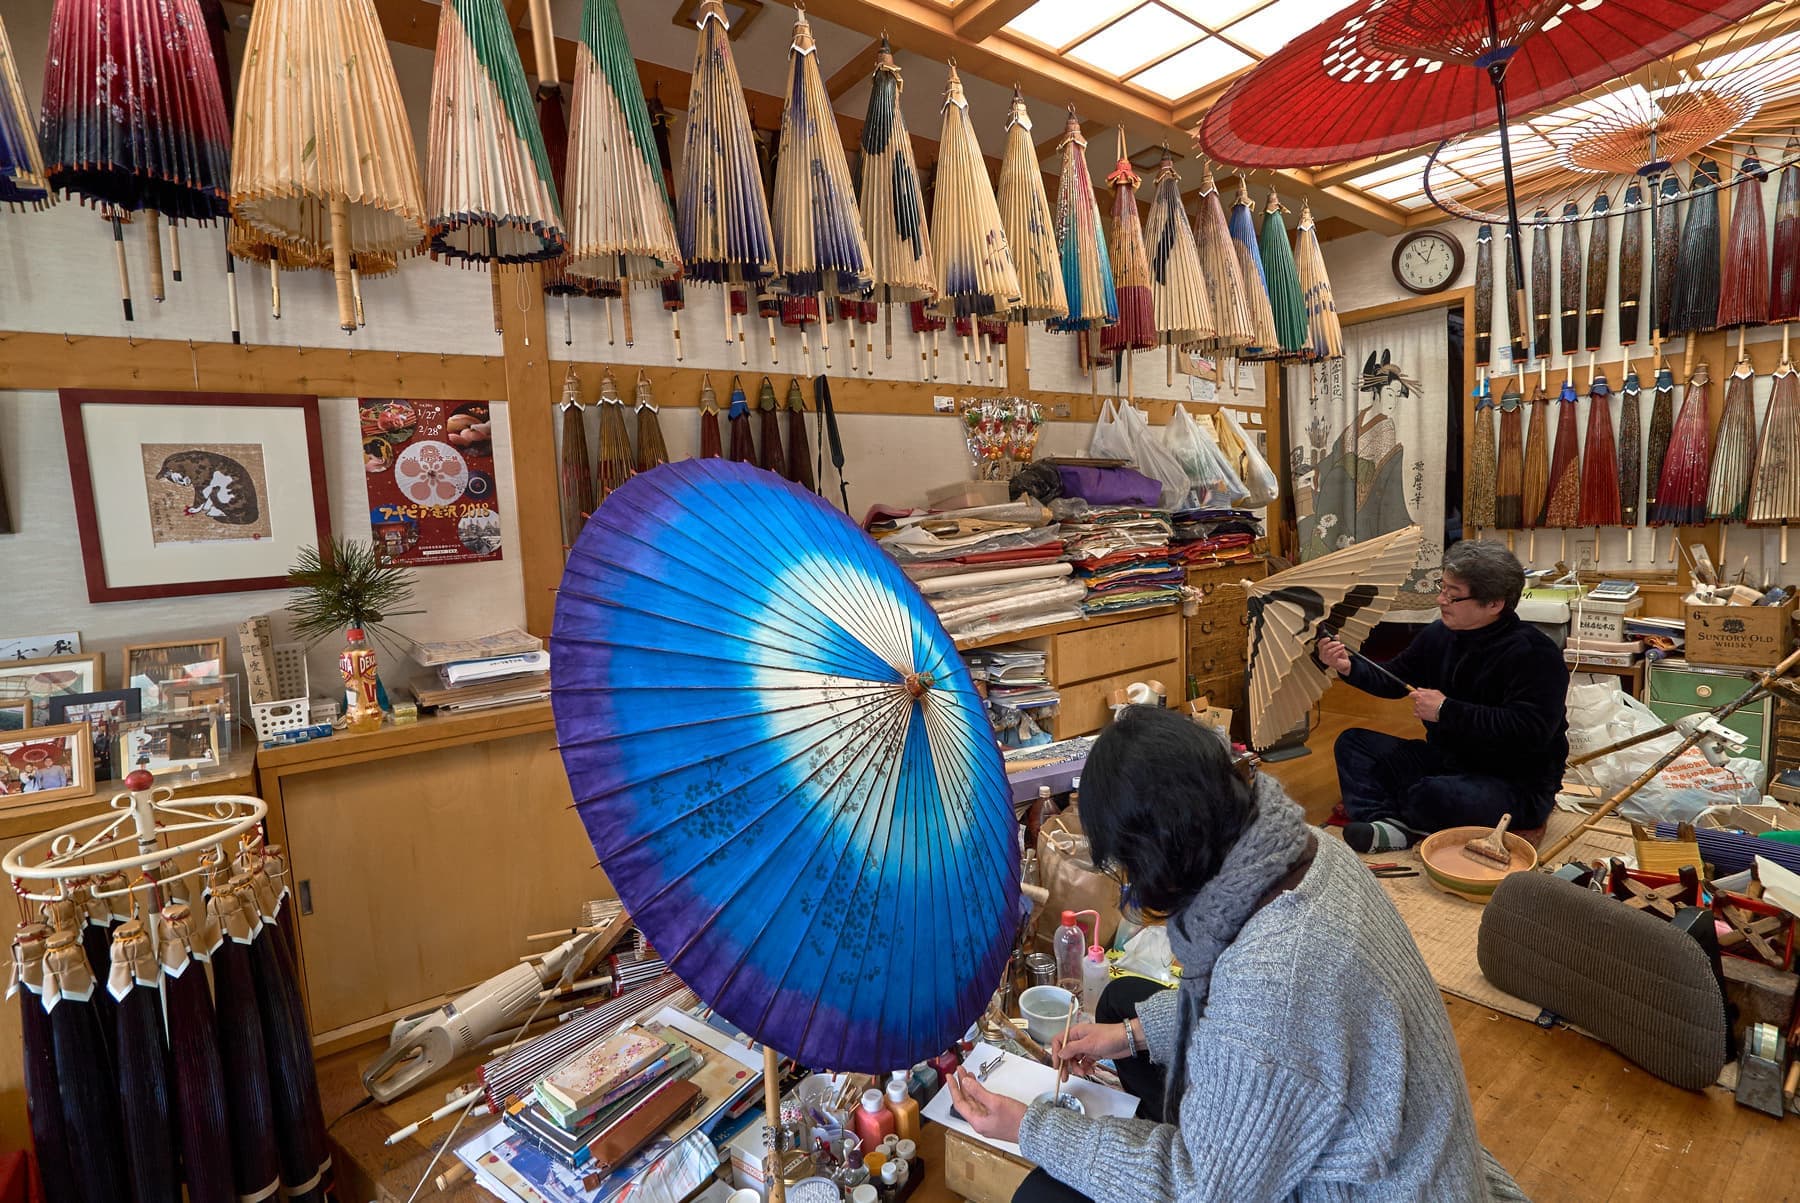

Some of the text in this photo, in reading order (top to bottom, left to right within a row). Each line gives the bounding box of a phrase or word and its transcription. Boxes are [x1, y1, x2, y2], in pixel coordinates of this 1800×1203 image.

[418, 425, 439, 436] 2/28
[460, 502, 490, 519] 2018
[1693, 611, 1701, 620] 6
[1697, 632, 1774, 643] SUNTORY OLD
[1714, 641, 1754, 649] WHISKY
